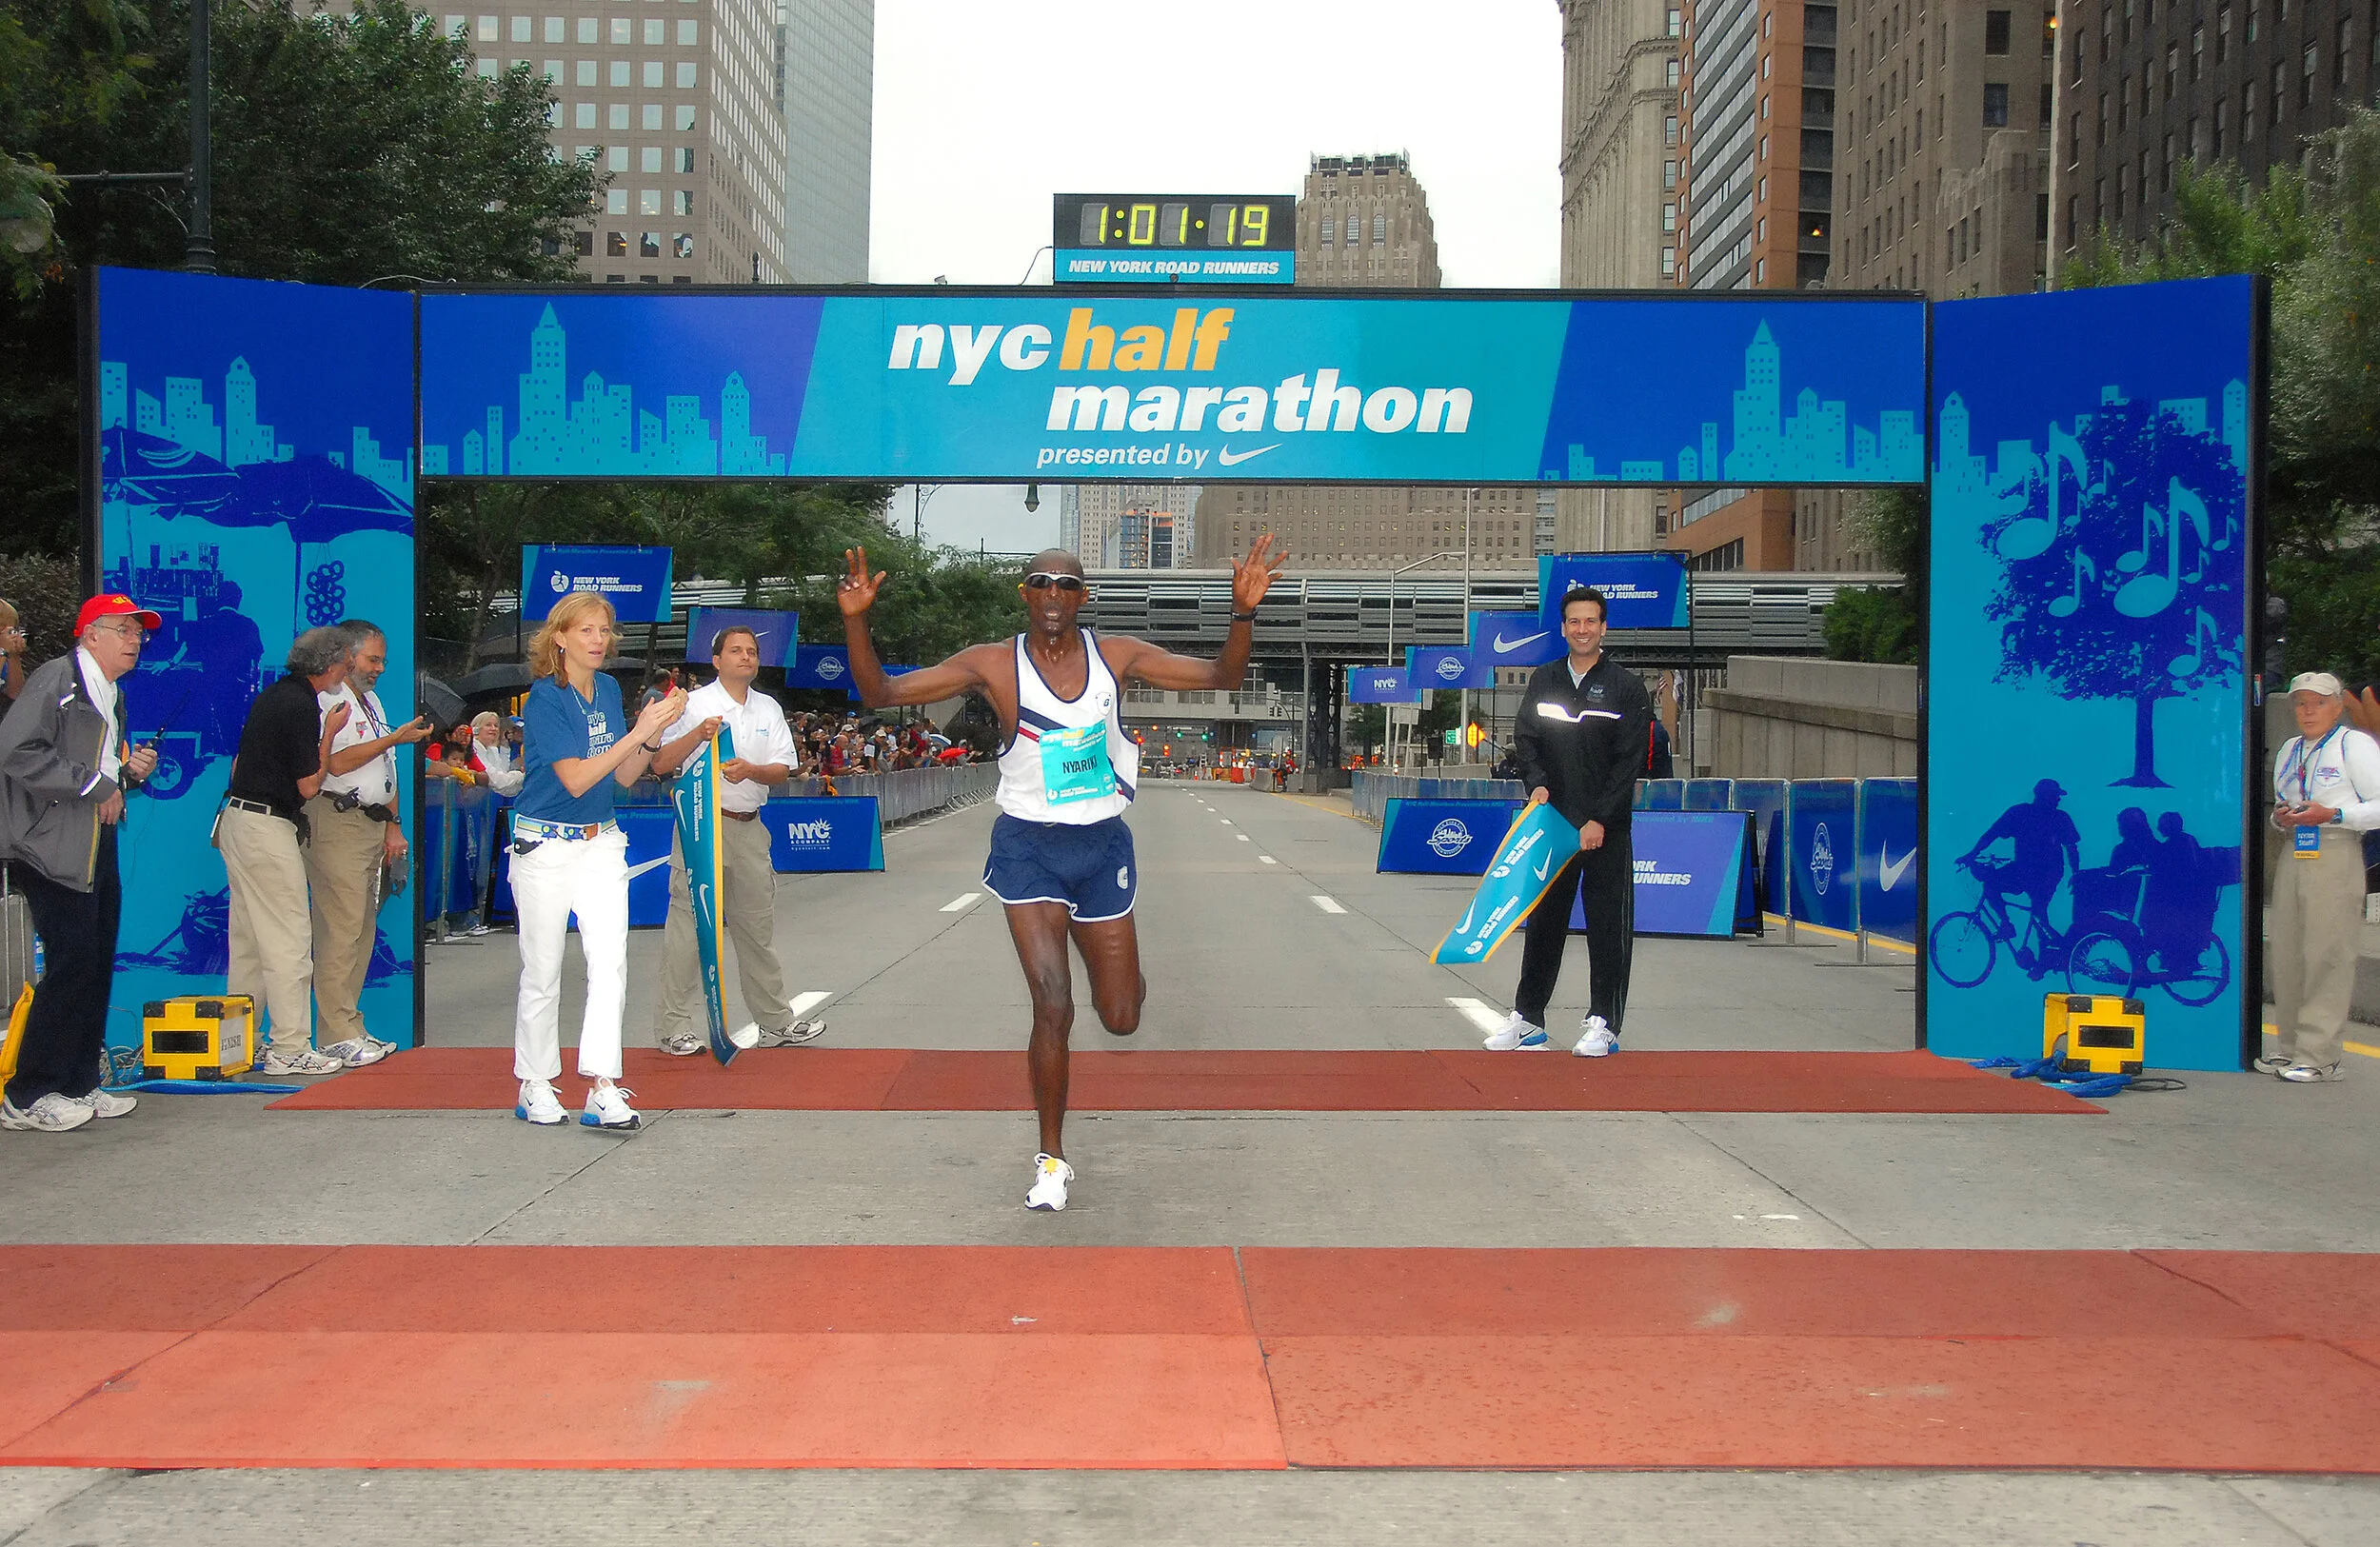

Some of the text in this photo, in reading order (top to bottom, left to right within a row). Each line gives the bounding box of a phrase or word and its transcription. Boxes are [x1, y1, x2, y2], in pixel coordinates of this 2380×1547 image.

[1068, 260, 1279, 275] NEW YORK ROAD RUNNERS
[887, 307, 1235, 386] nyc half
[1045, 368, 1473, 434] marathon
[1036, 443, 1209, 469] presented by
[573, 576, 595, 584] NEW
[573, 584, 643, 592] ROAD RUNNERS
[1374, 679, 1397, 688] NYC
[587, 712, 605, 725] nyc
[588, 722, 606, 736] half
[788, 820, 831, 839] NYC
[1633, 861, 1657, 872] RK
[1633, 873, 1691, 886] UNNERS
